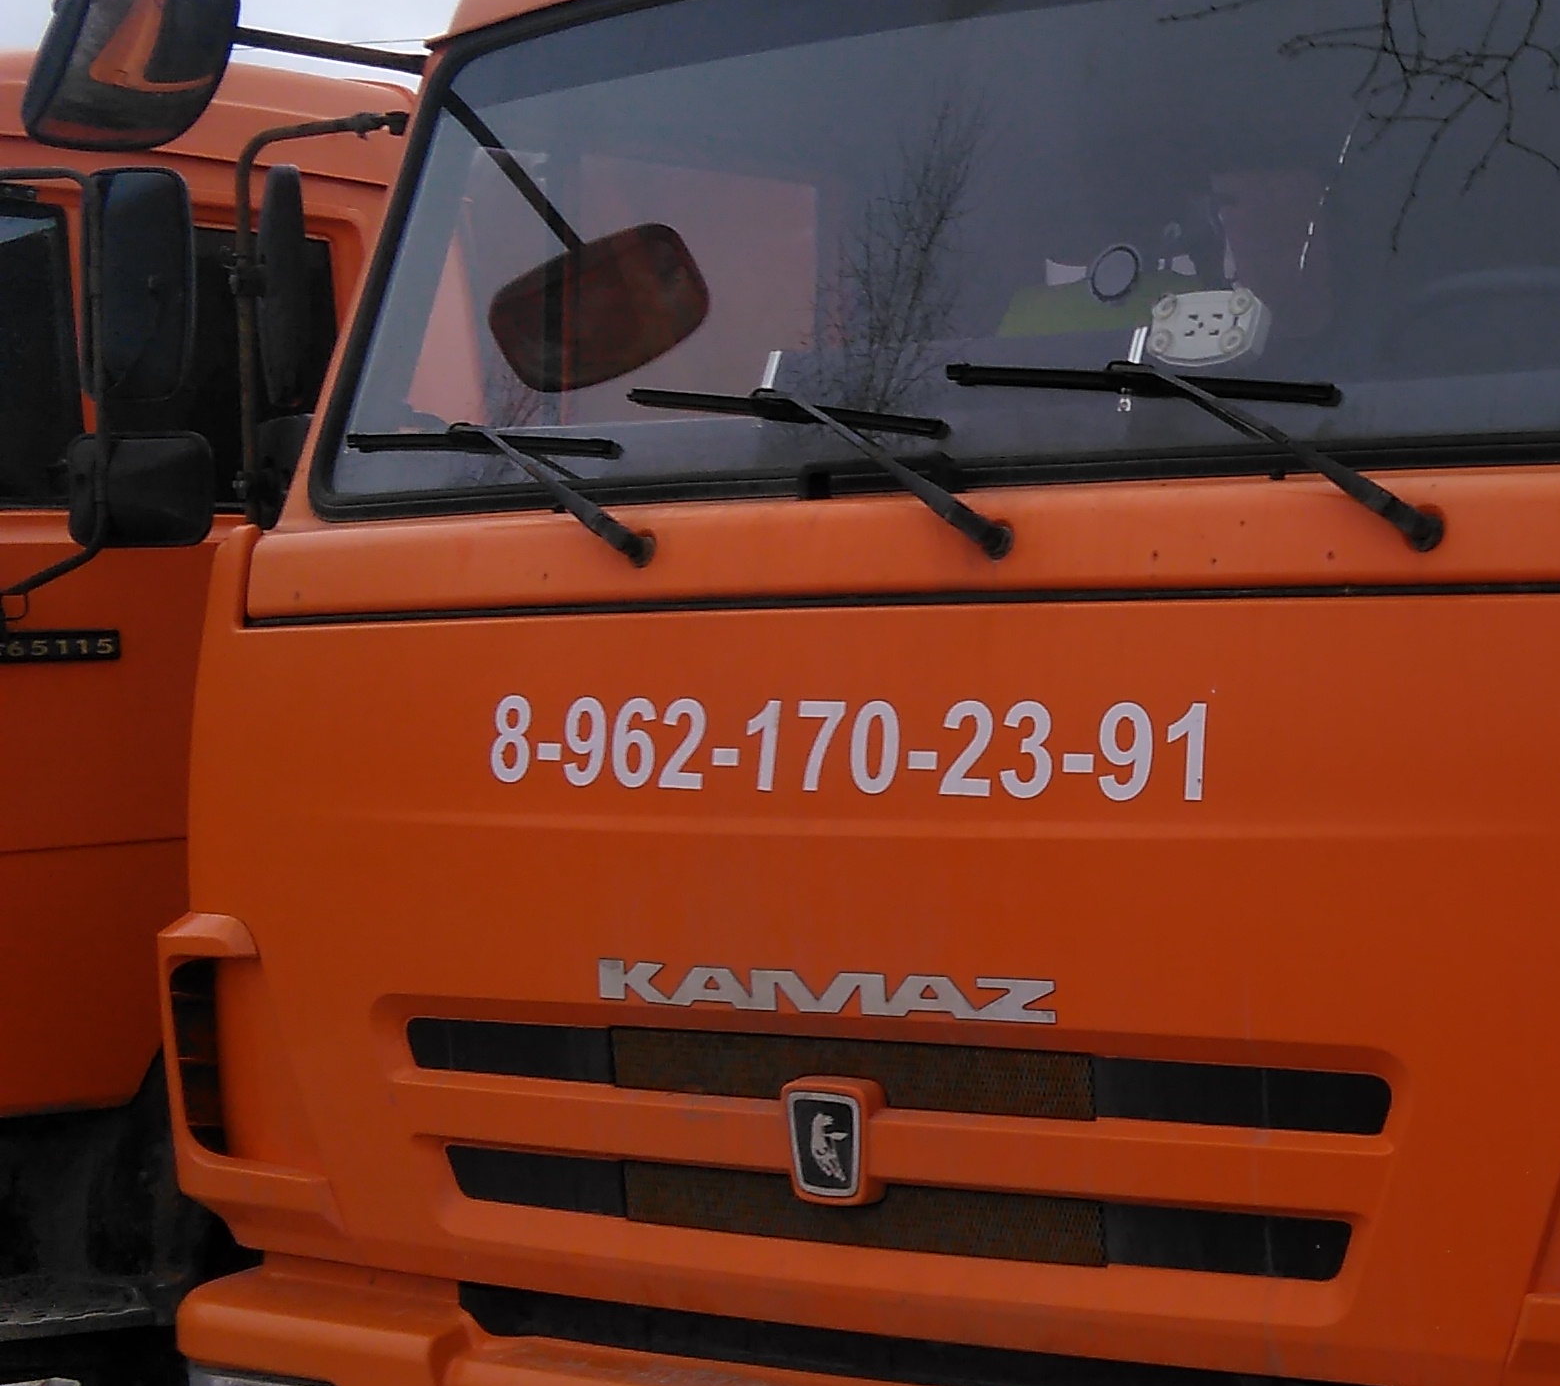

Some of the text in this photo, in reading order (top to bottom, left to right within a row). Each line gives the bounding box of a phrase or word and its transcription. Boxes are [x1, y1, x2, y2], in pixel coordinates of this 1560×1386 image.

[0, 638, 114, 657] 65115
[490, 694, 1209, 802] 8-962-170-23-91
[598, 958, 1057, 1024] KAMAZ
